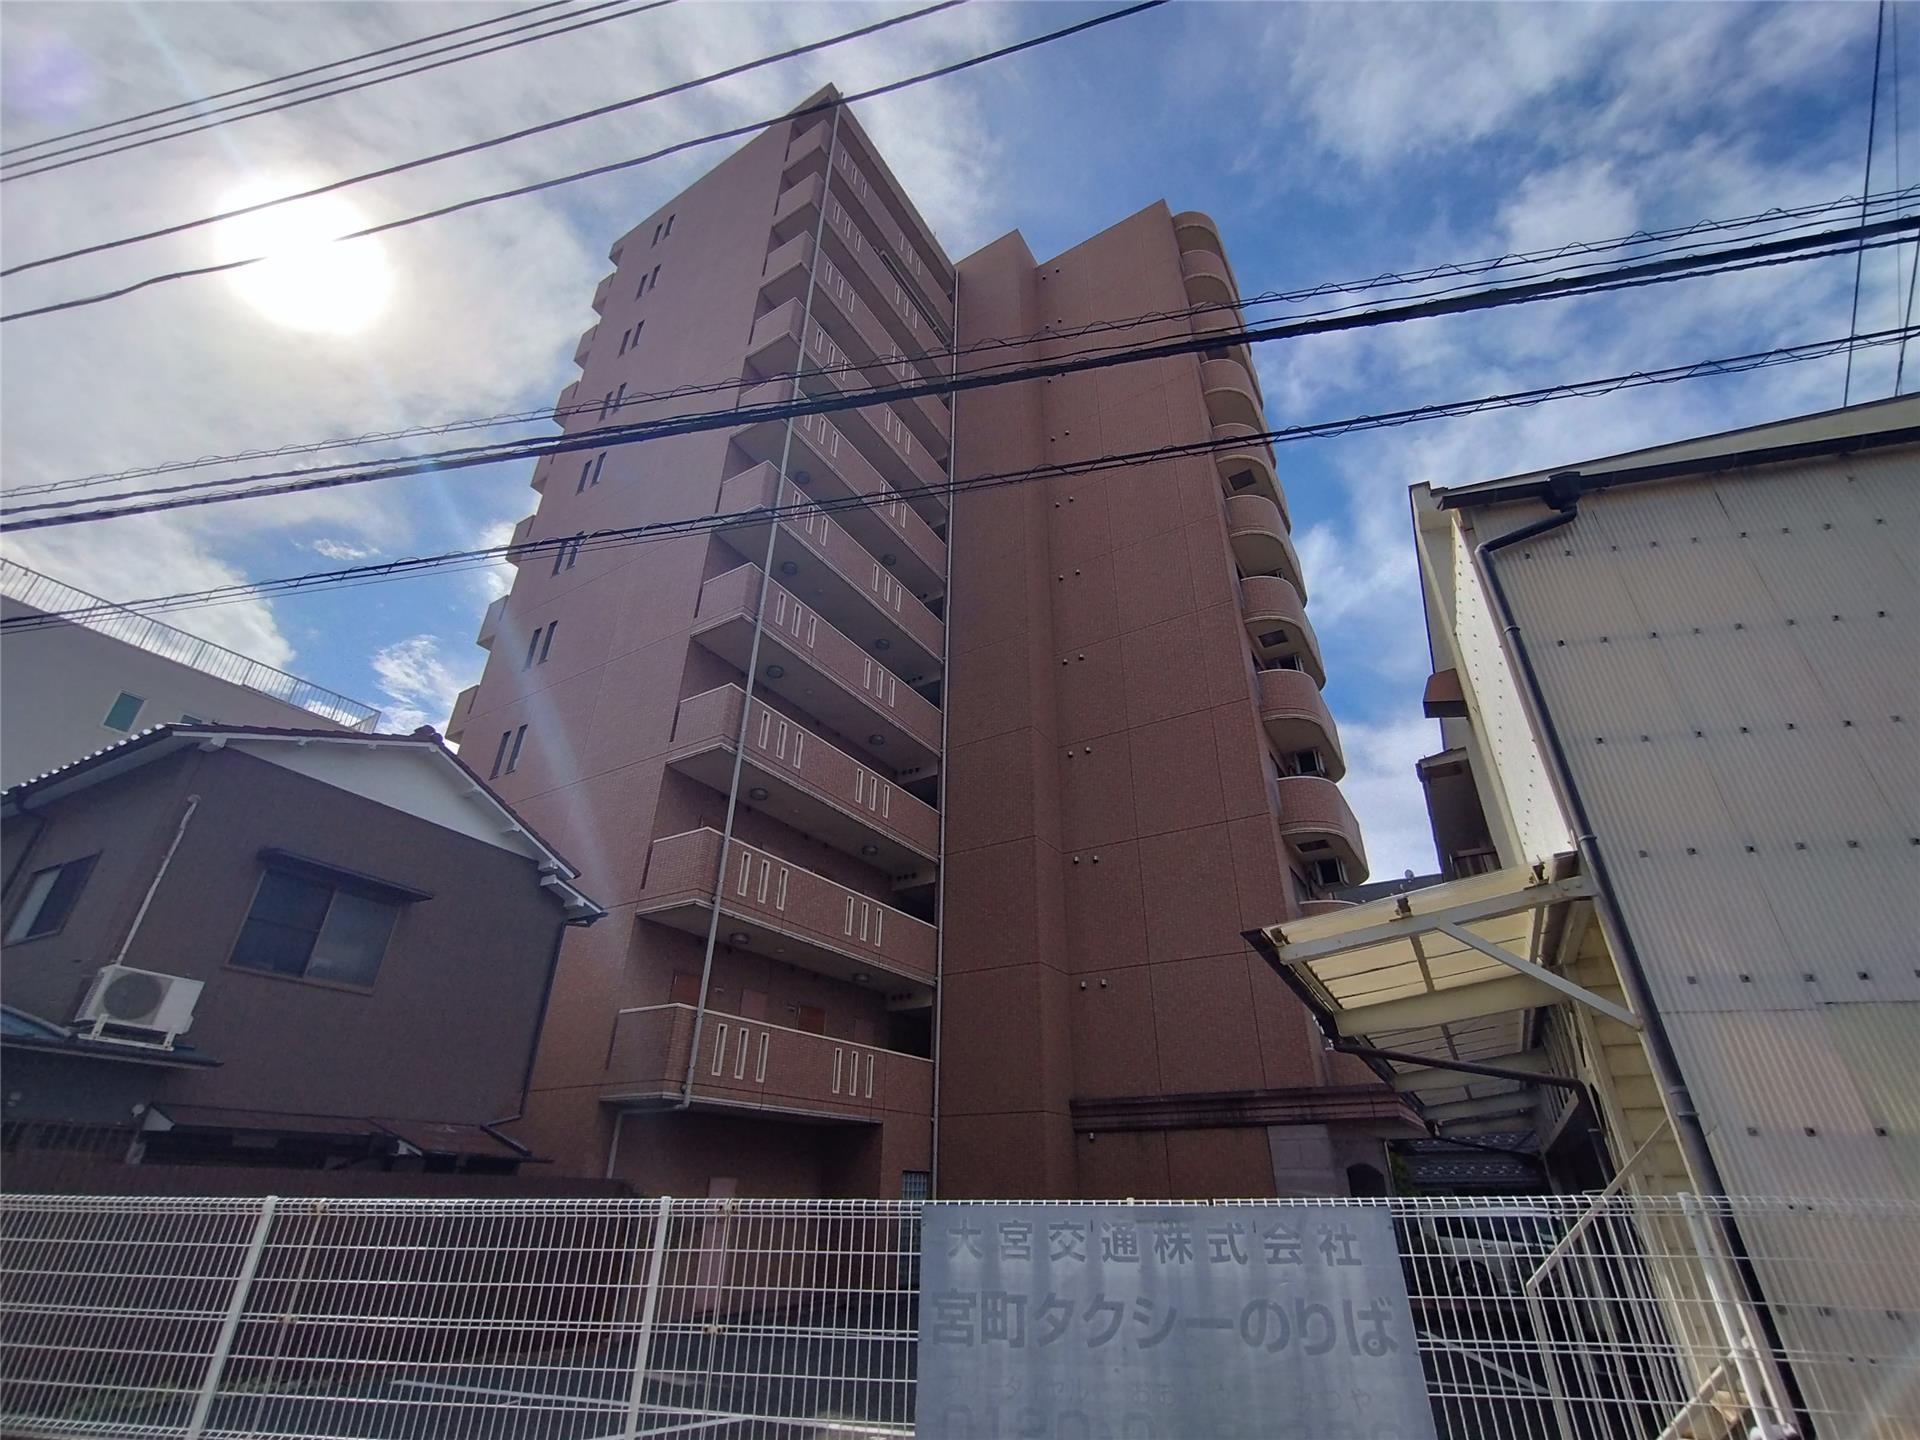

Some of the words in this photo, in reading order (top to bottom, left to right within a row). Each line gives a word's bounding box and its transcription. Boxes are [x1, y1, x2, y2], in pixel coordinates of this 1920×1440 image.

[947, 1219, 1363, 1267] 大宮交通株式会社
[931, 1289, 1398, 1357] 宮町タクシーのりば
